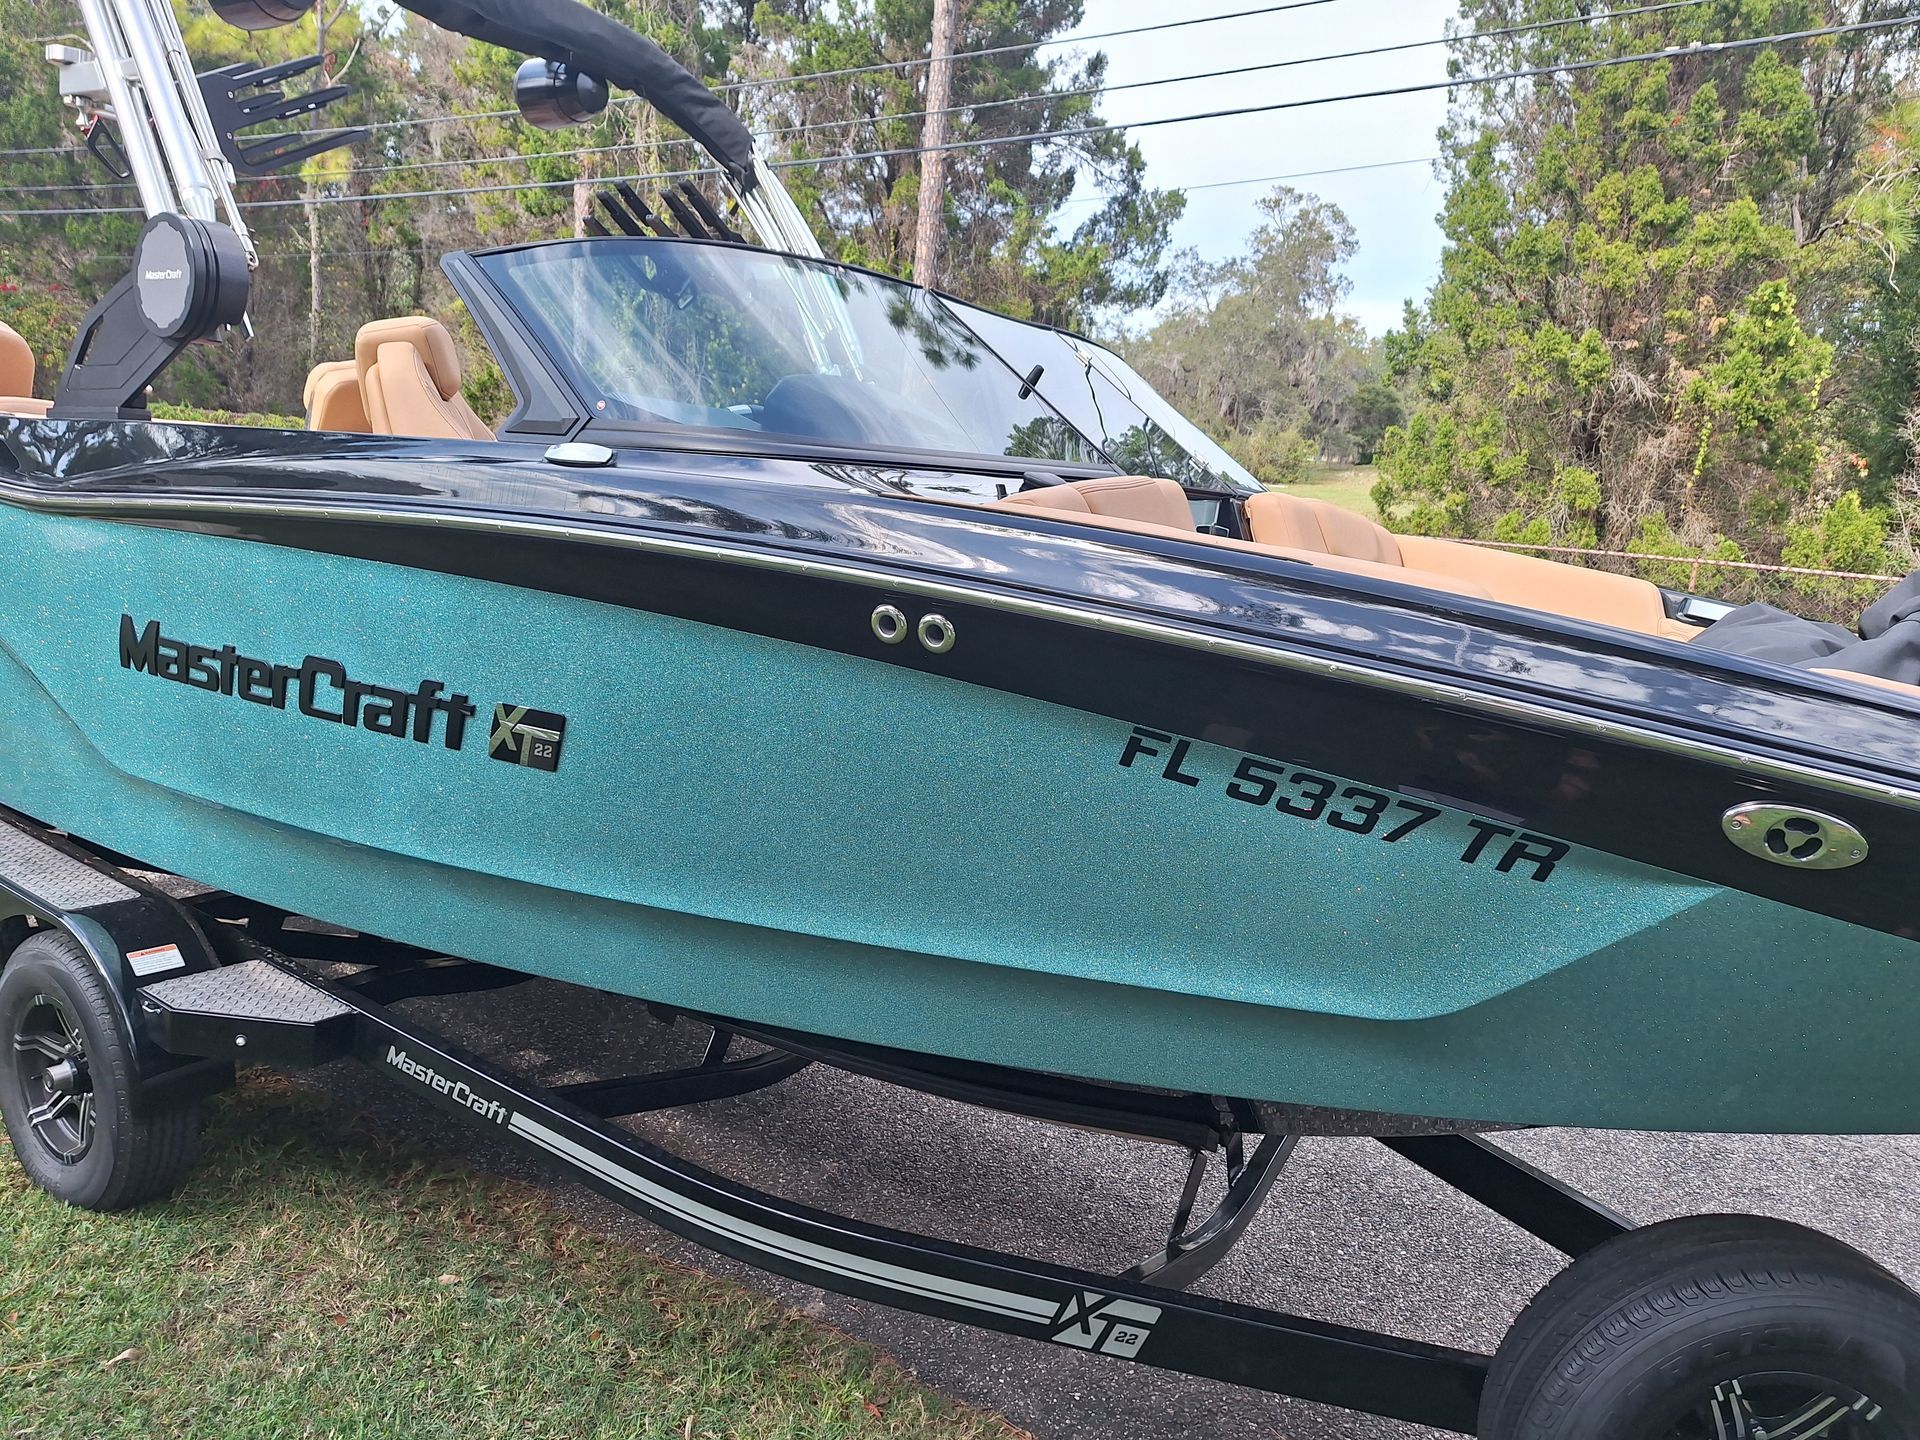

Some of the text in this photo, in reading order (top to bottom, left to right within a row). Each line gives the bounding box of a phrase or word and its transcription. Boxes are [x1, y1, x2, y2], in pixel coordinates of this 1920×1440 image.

[145, 269, 182, 280] MasterCraft
[119, 613, 476, 751] MasterCraft
[489, 702, 561, 767] XT 22
[1118, 726, 1570, 882] FL 5337 TR
[386, 1045, 508, 1124] MasterCraft
[1052, 1291, 1154, 1352] XT 22
